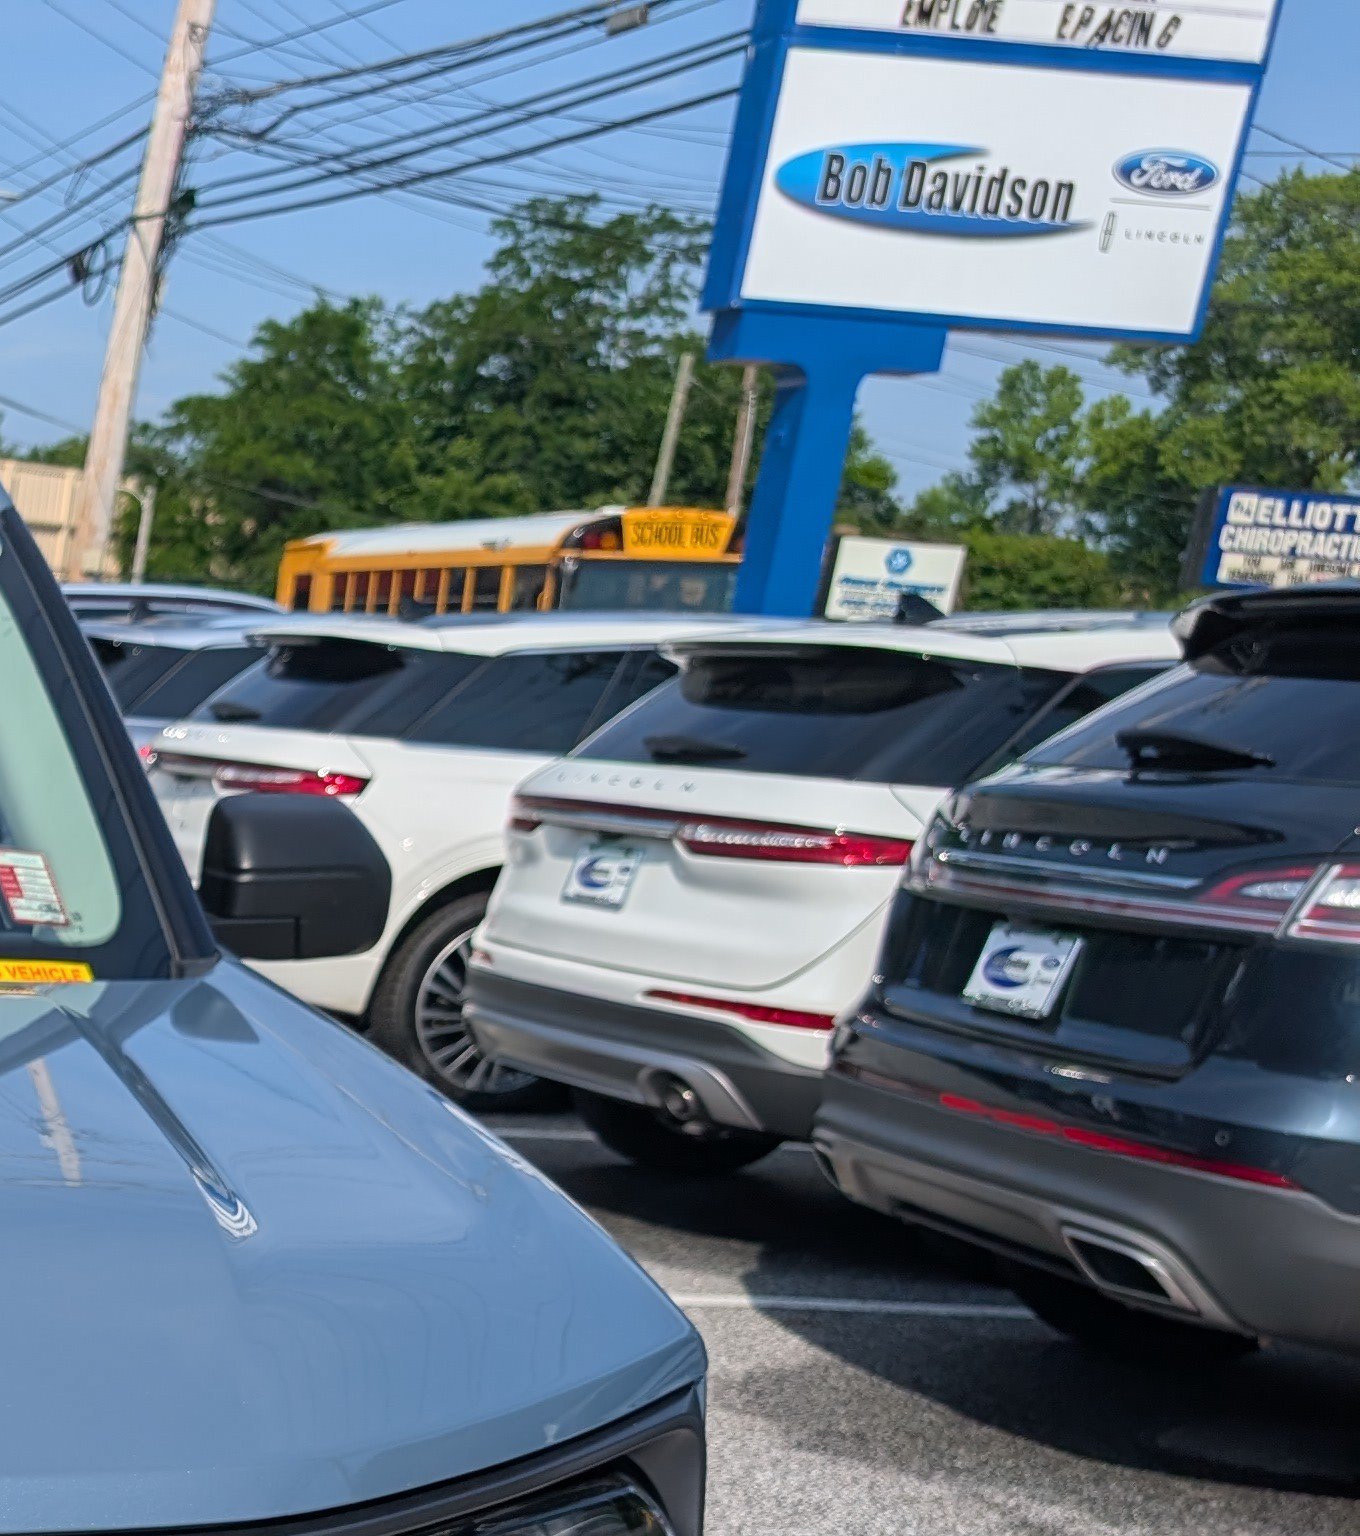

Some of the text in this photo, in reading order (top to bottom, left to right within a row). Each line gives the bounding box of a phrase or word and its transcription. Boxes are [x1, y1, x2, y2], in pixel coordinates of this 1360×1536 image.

[820, 153, 1074, 224] Bob Davidson
[1129, 155, 1205, 192] Ford
[1124, 228, 1205, 245] LINCOLN
